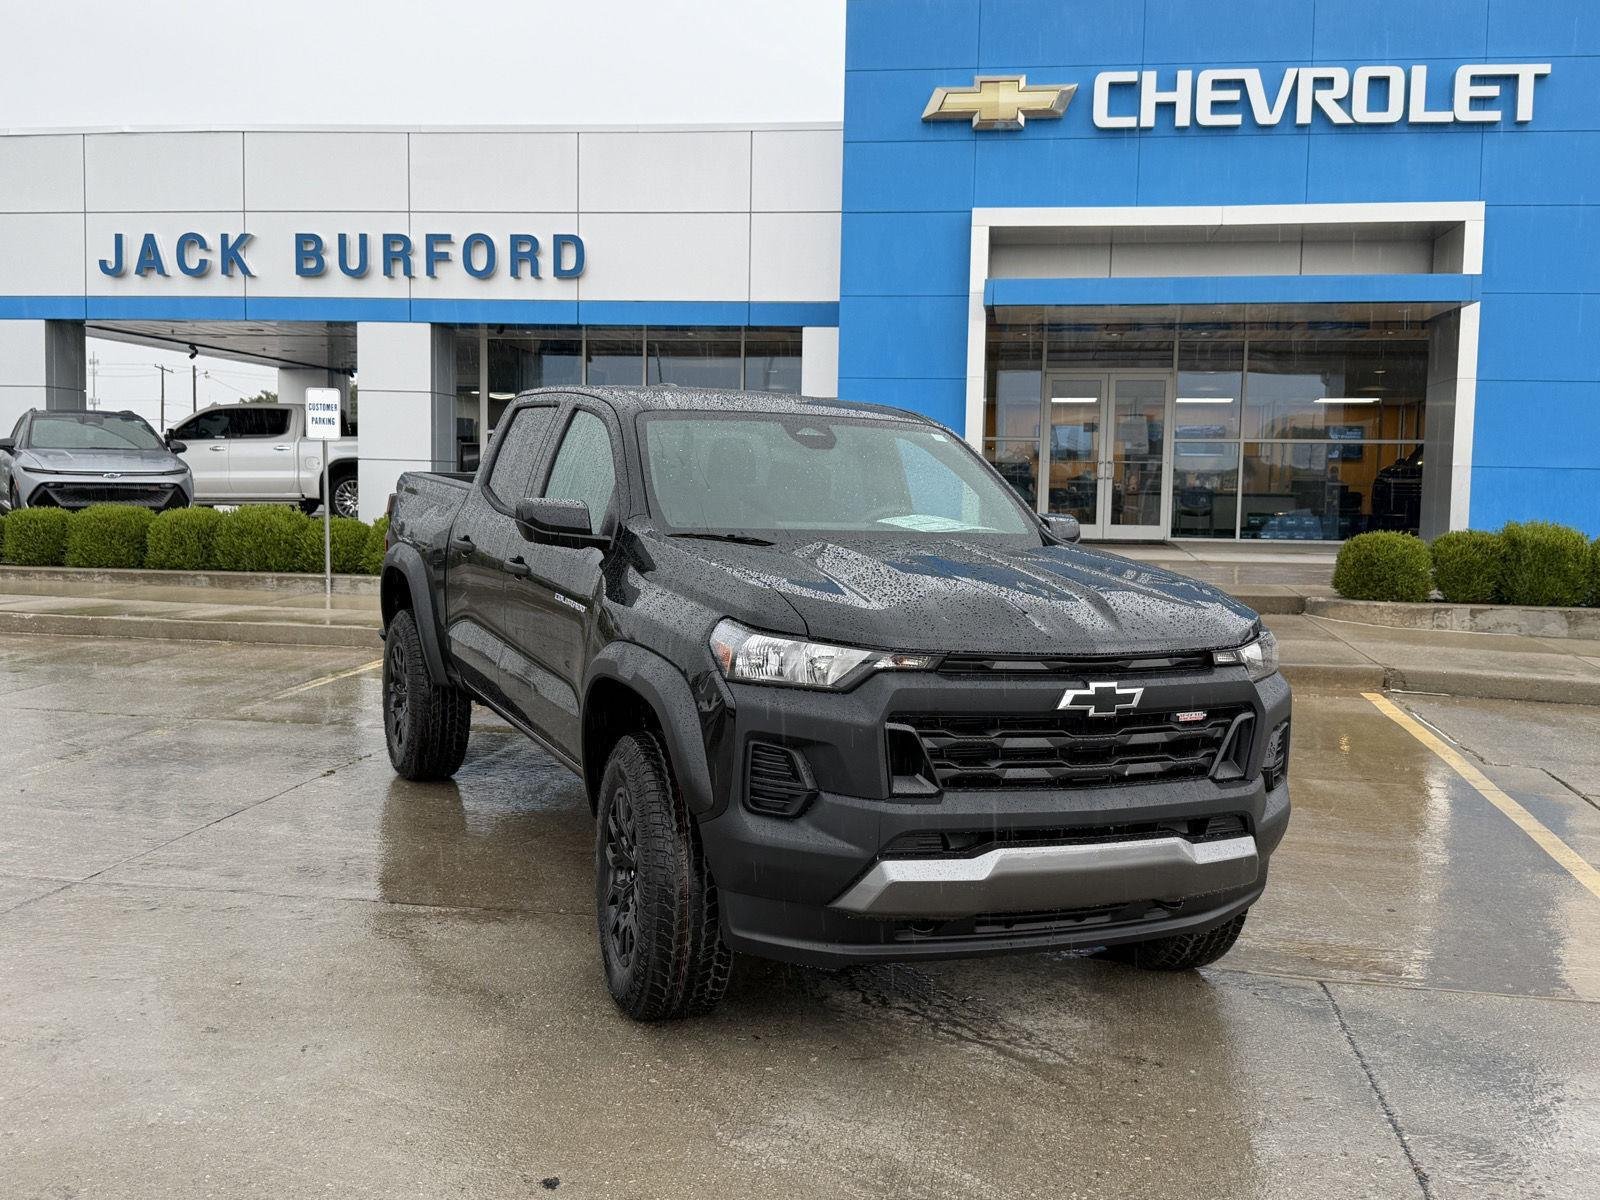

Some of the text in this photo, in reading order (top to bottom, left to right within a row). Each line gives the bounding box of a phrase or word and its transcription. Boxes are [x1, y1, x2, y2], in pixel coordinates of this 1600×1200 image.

[1092, 63, 1552, 129] CHEVROLET
[98, 232, 586, 279] JACK BURFORD
[308, 402, 338, 412] CUSTOMER
[311, 416, 336, 426] PARKING
